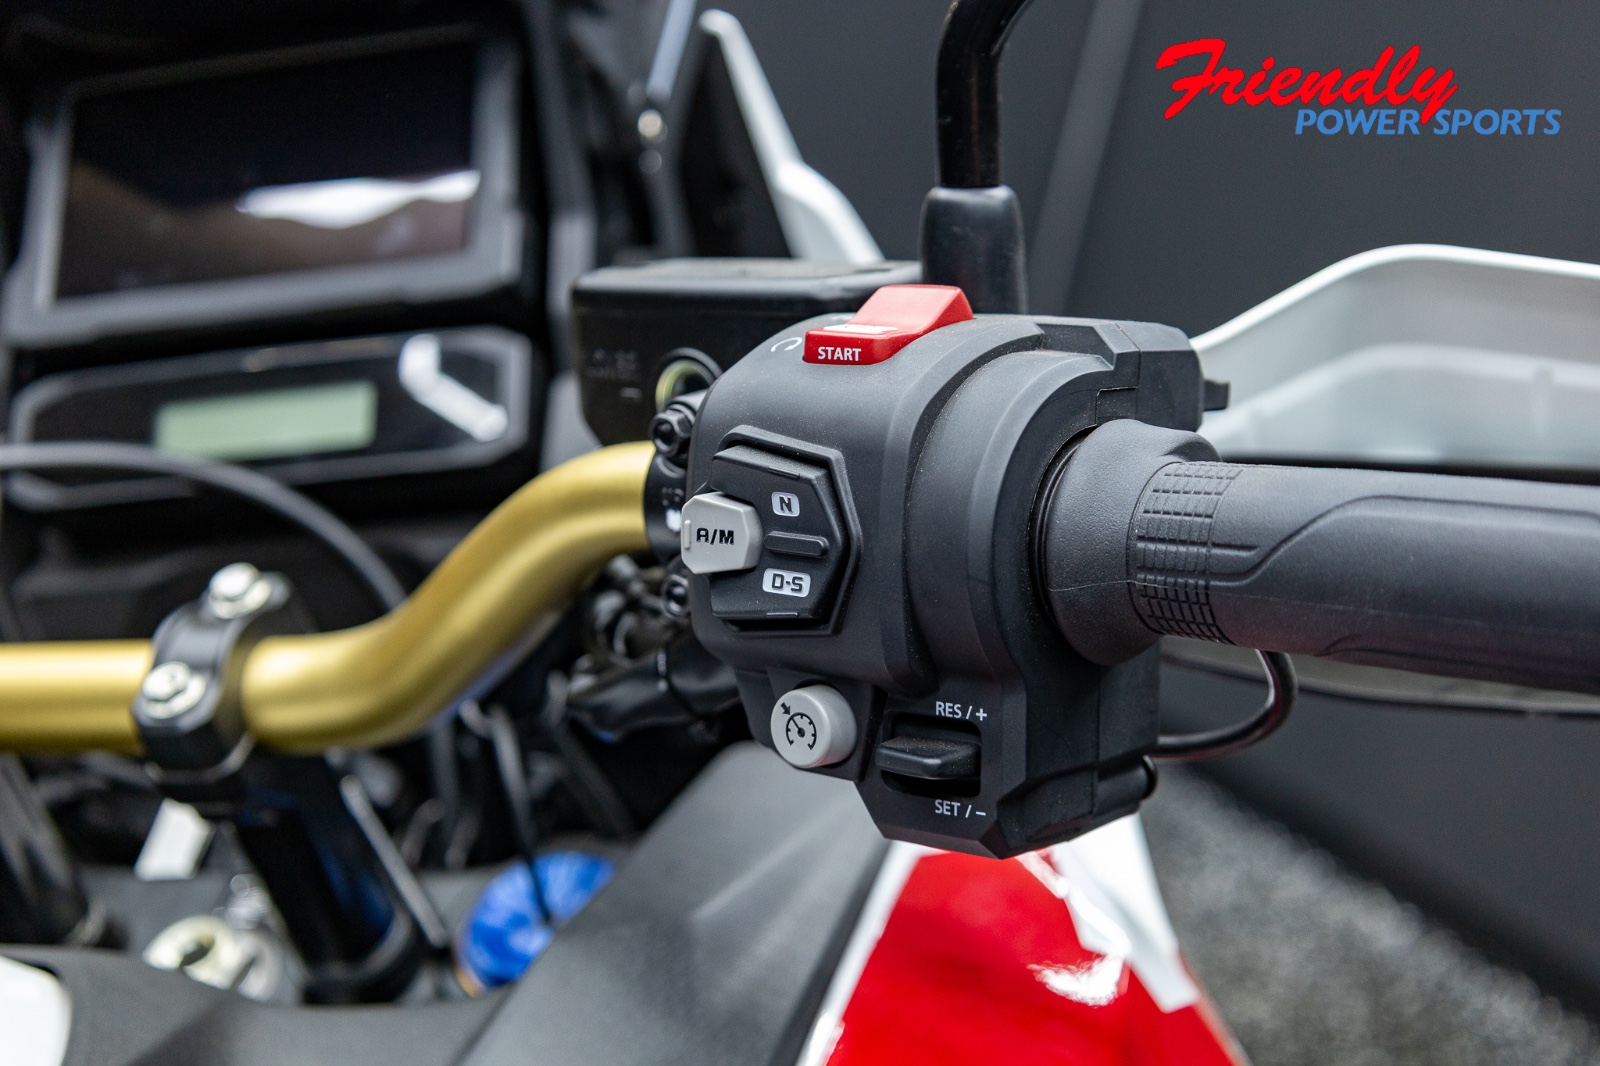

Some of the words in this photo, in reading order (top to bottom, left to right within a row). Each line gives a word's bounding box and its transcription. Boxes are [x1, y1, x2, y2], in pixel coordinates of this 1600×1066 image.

[817, 346, 862, 362] START
[778, 496, 793, 513] N
[695, 527, 735, 546] A/M
